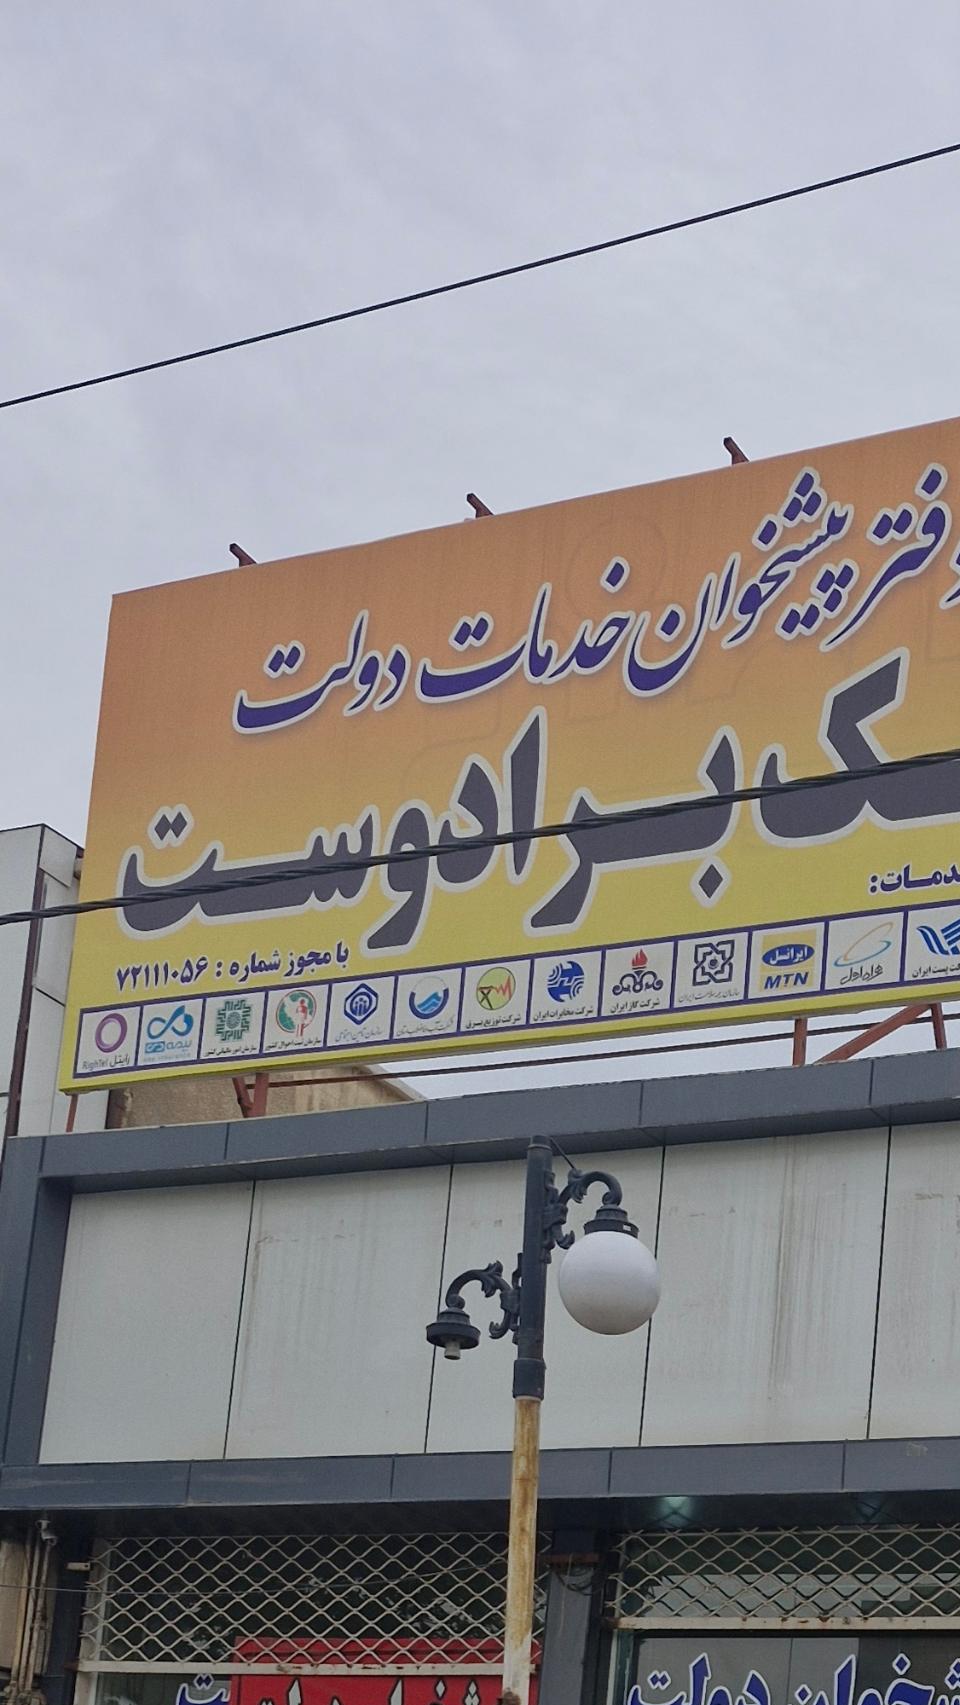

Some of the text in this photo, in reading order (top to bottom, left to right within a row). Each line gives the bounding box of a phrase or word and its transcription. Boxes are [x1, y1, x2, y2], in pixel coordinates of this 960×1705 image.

[624, 465, 855, 699] پیشخوان
[415, 553, 637, 702] خدمات
[232, 609, 410, 735] دولت
[116, 705, 746, 960] برادوست
[229, 949, 281, 983] شماره
[283, 950, 331, 977] مجوز
[335, 941, 349, 968] با
[769, 946, 808, 965] ایرانسل
[763, 971, 809, 990] MTN
